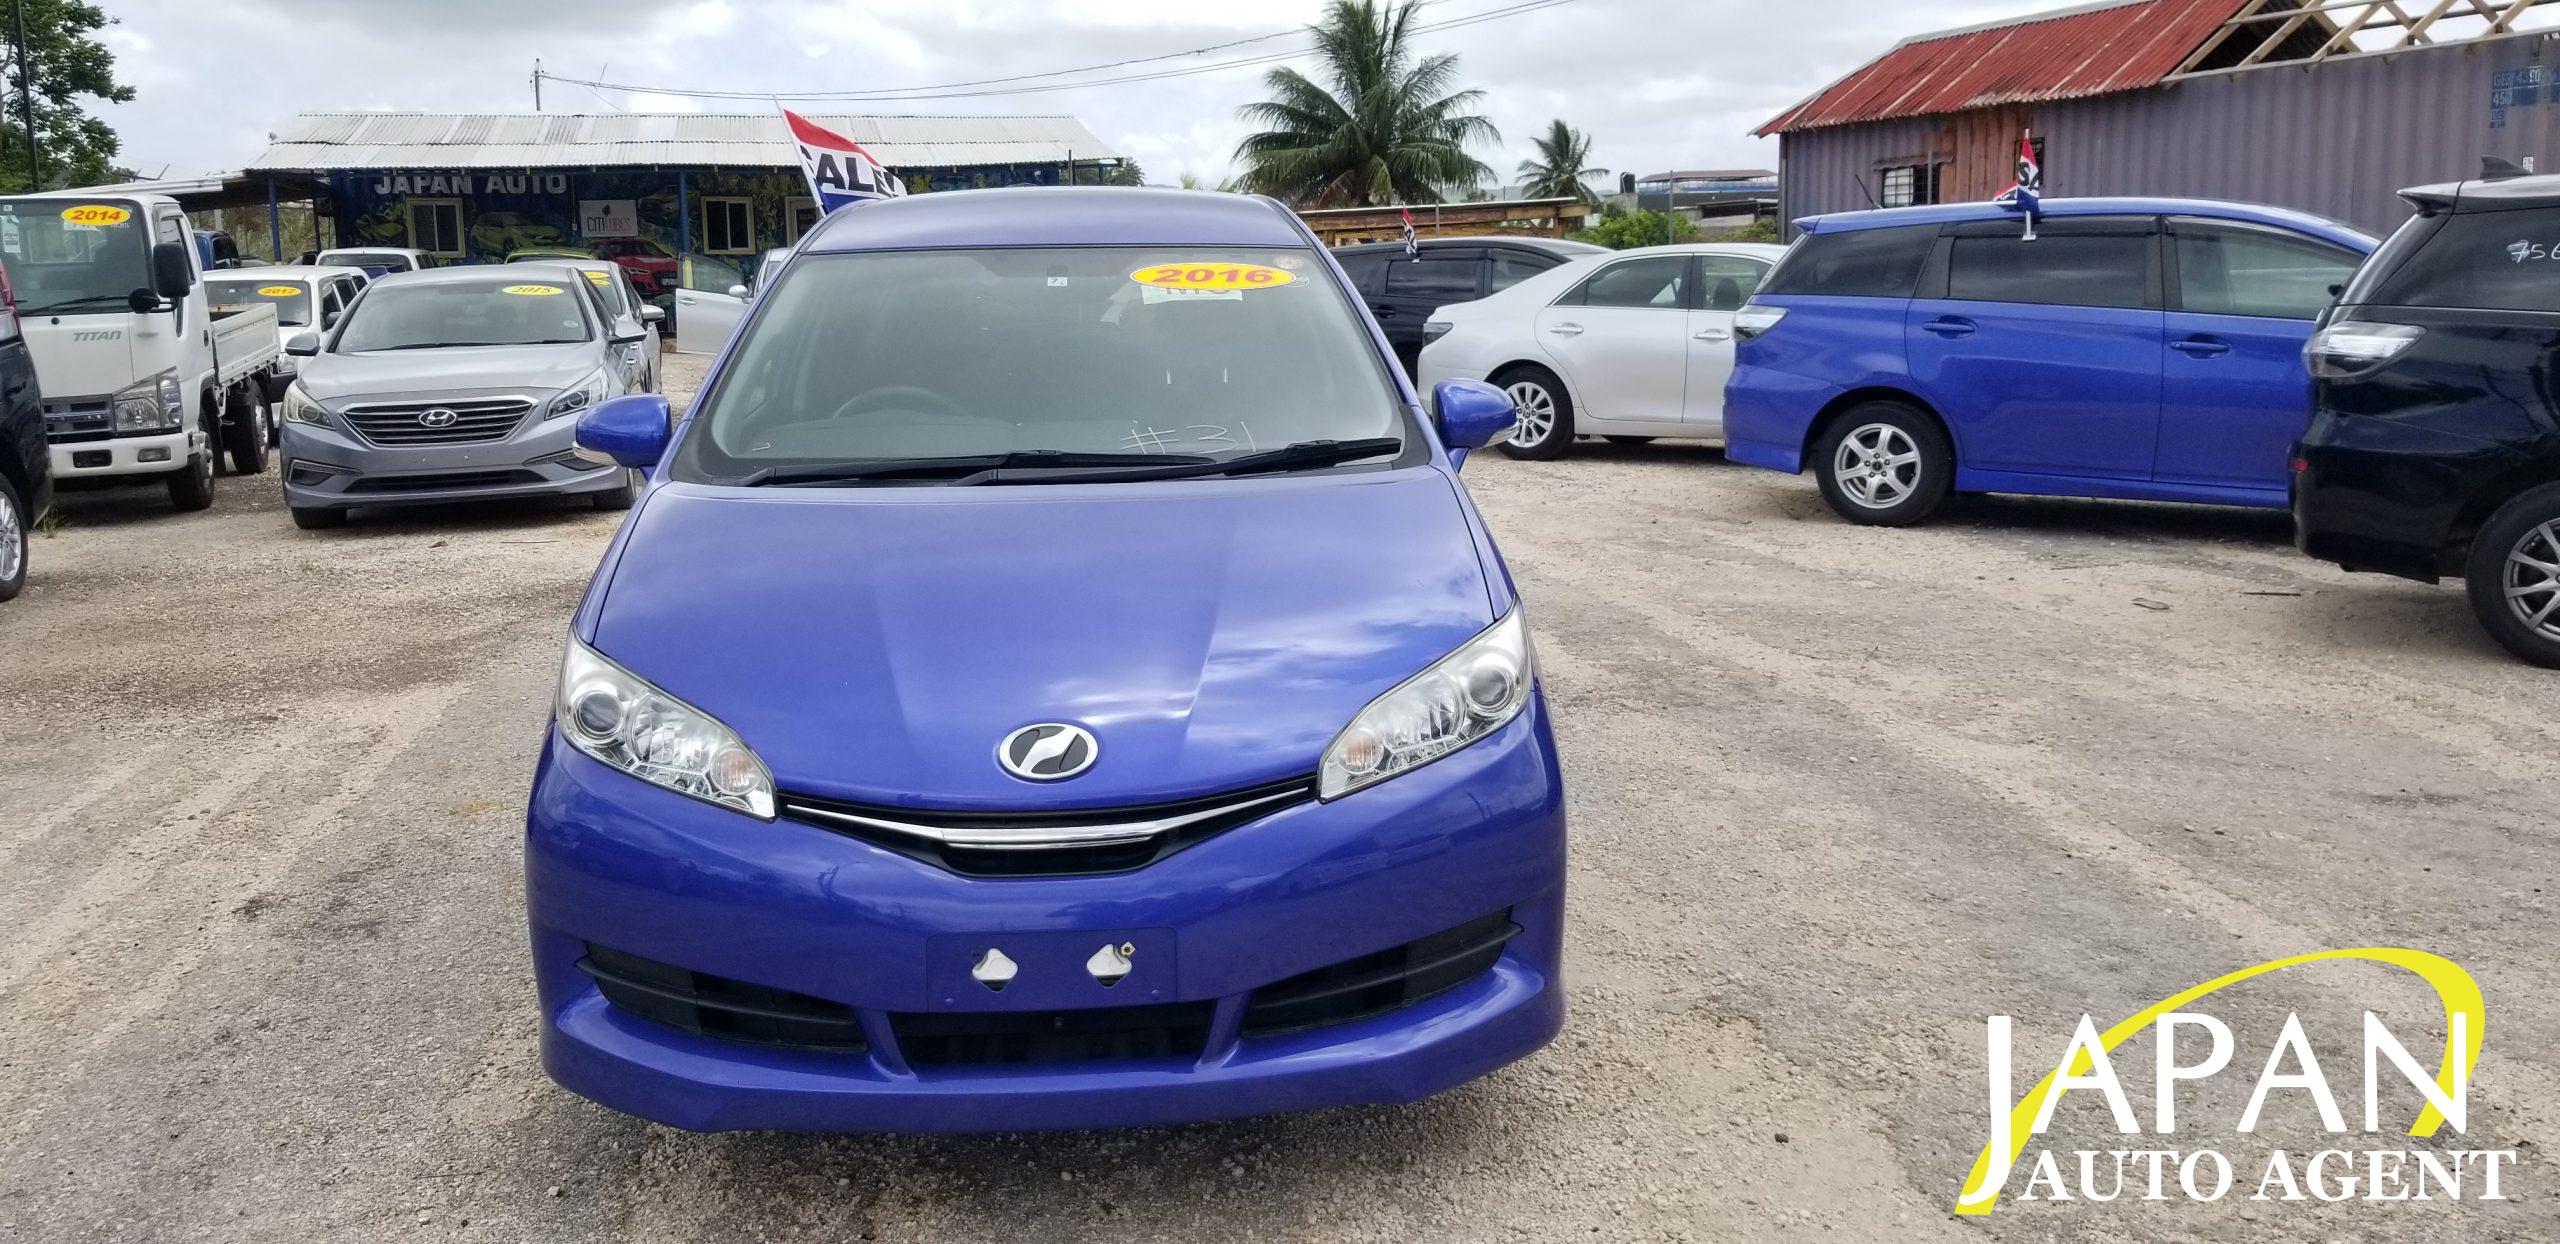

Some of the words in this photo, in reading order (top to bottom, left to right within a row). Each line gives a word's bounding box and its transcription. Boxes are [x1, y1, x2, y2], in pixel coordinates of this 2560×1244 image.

[374, 173, 473, 195] JAPAN
[485, 173, 567, 194] AUTO
[71, 210, 121, 221] 2014
[1151, 269, 1274, 284] 2016
[515, 285, 551, 294] 2015
[73, 330, 121, 342] TITAN
